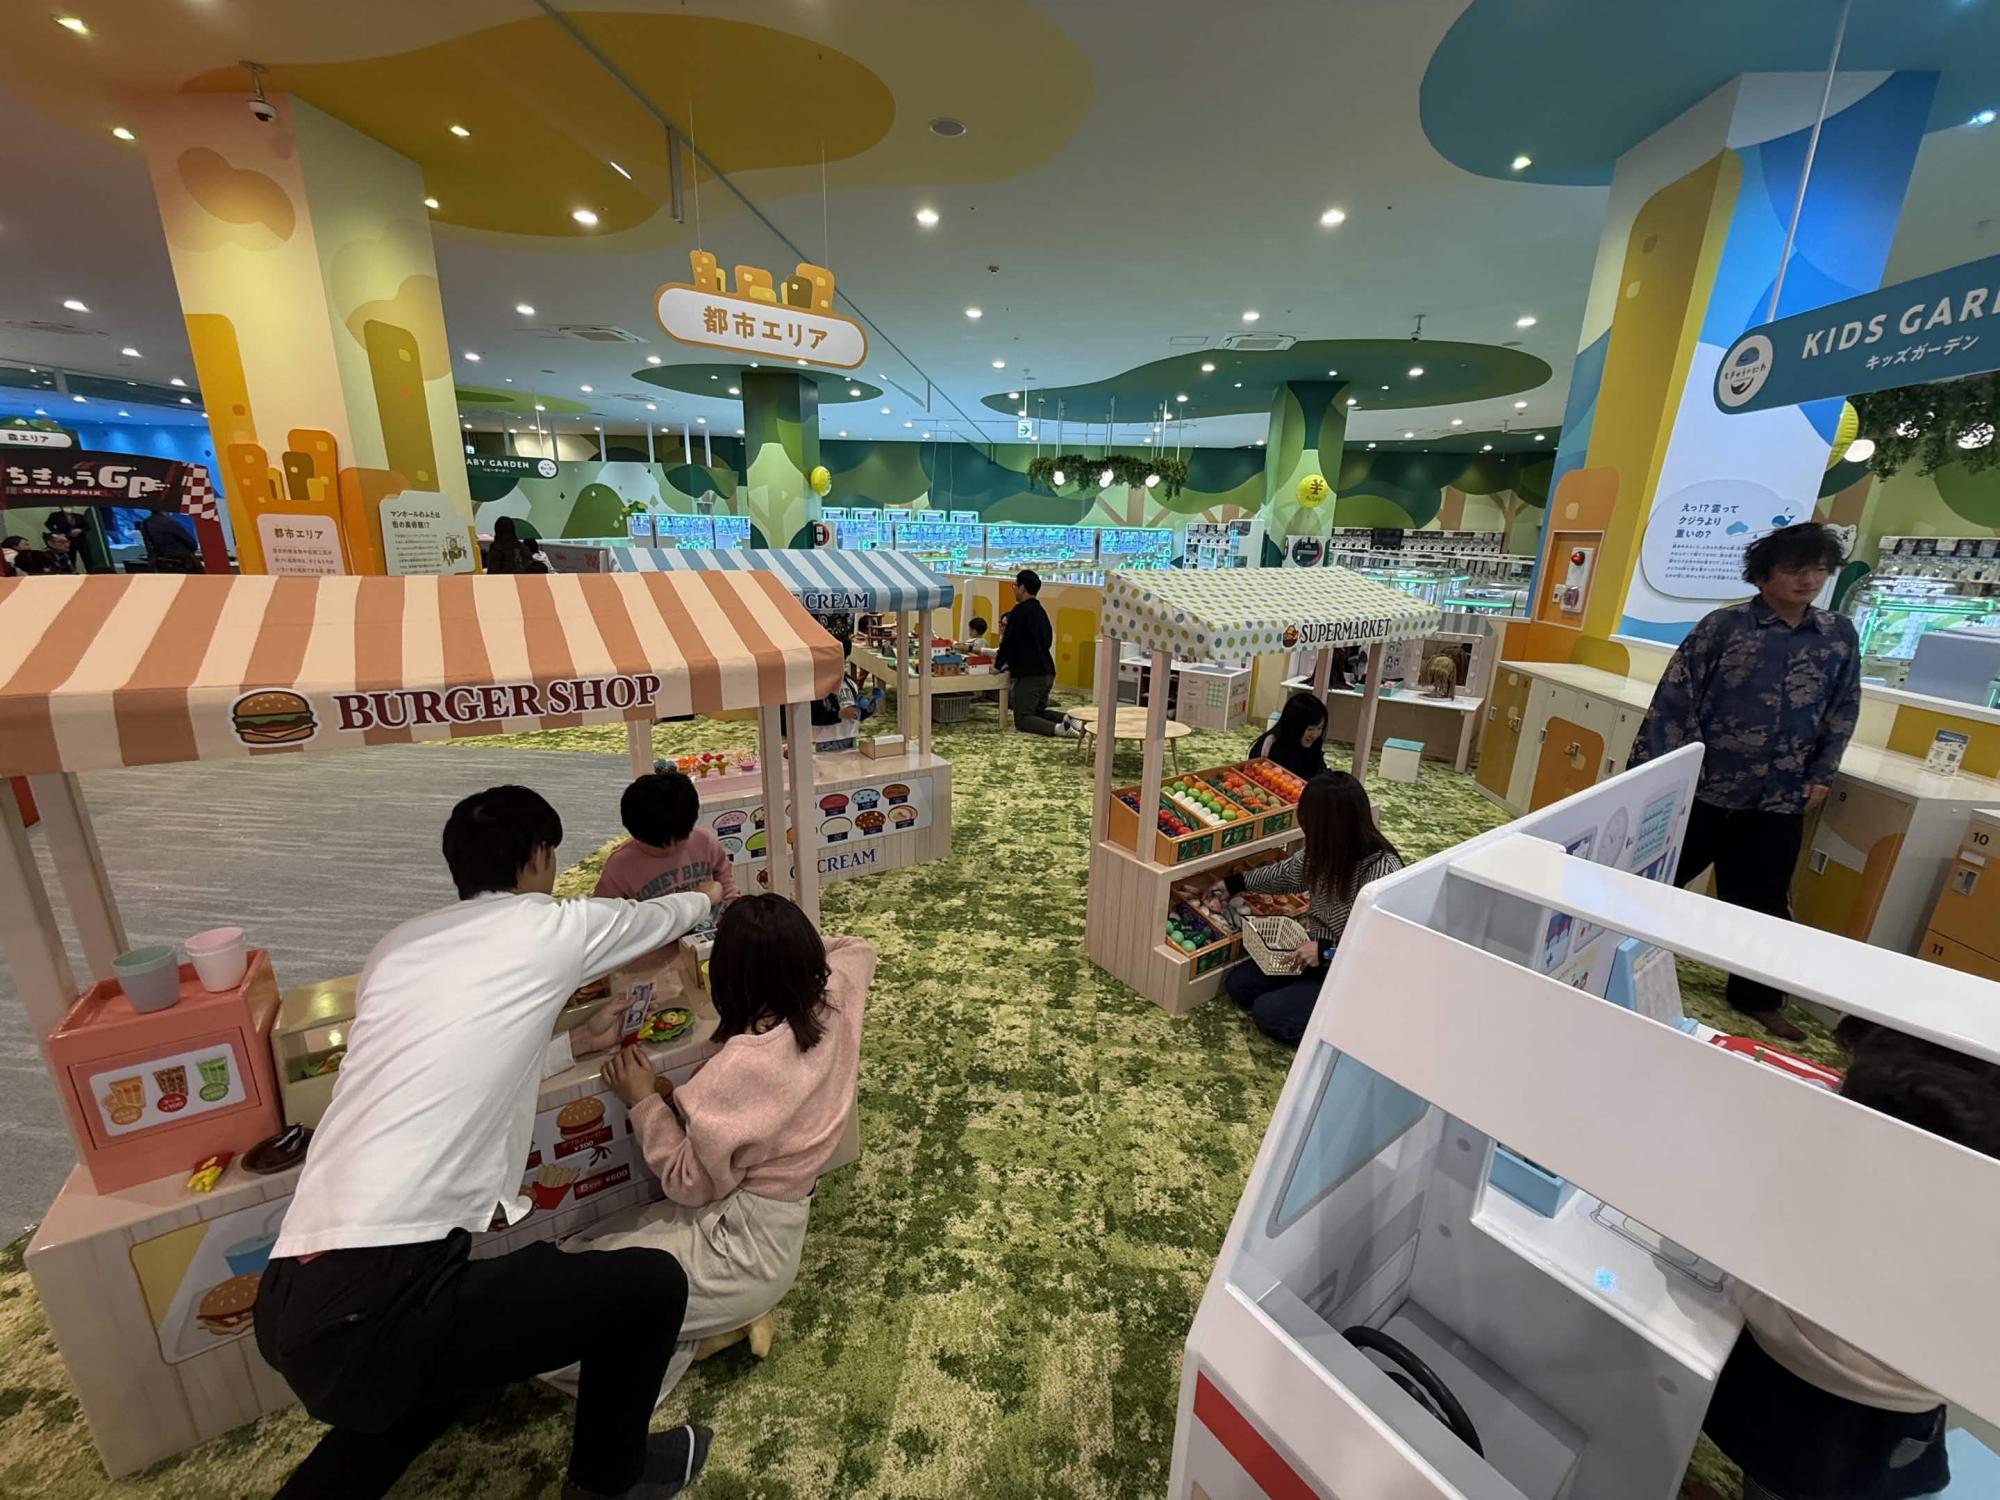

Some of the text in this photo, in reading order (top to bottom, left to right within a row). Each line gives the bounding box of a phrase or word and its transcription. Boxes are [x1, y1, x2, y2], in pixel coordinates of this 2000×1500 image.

[703, 305, 828, 349] 都市エリア
[1802, 287, 2000, 360] KIDS GAR
[1865, 335, 1980, 370] キッズガーデン
[489, 460, 530, 468] GARDEN
[1678, 517, 1722, 526] クジラより
[274, 528, 324, 540] 都市エリア
[1675, 529, 1712, 539] 重いの?
[805, 593, 869, 609] CREAM
[1300, 618, 1392, 644] SUPERMARKET
[334, 675, 660, 730] BURGER SHOP
[1839, 791, 1847, 802] 9
[1972, 831, 1989, 846] 10
[817, 849, 876, 874] CREAM
[1931, 943, 1944, 956] 11
[605, 1169, 628, 1182] ¥600
